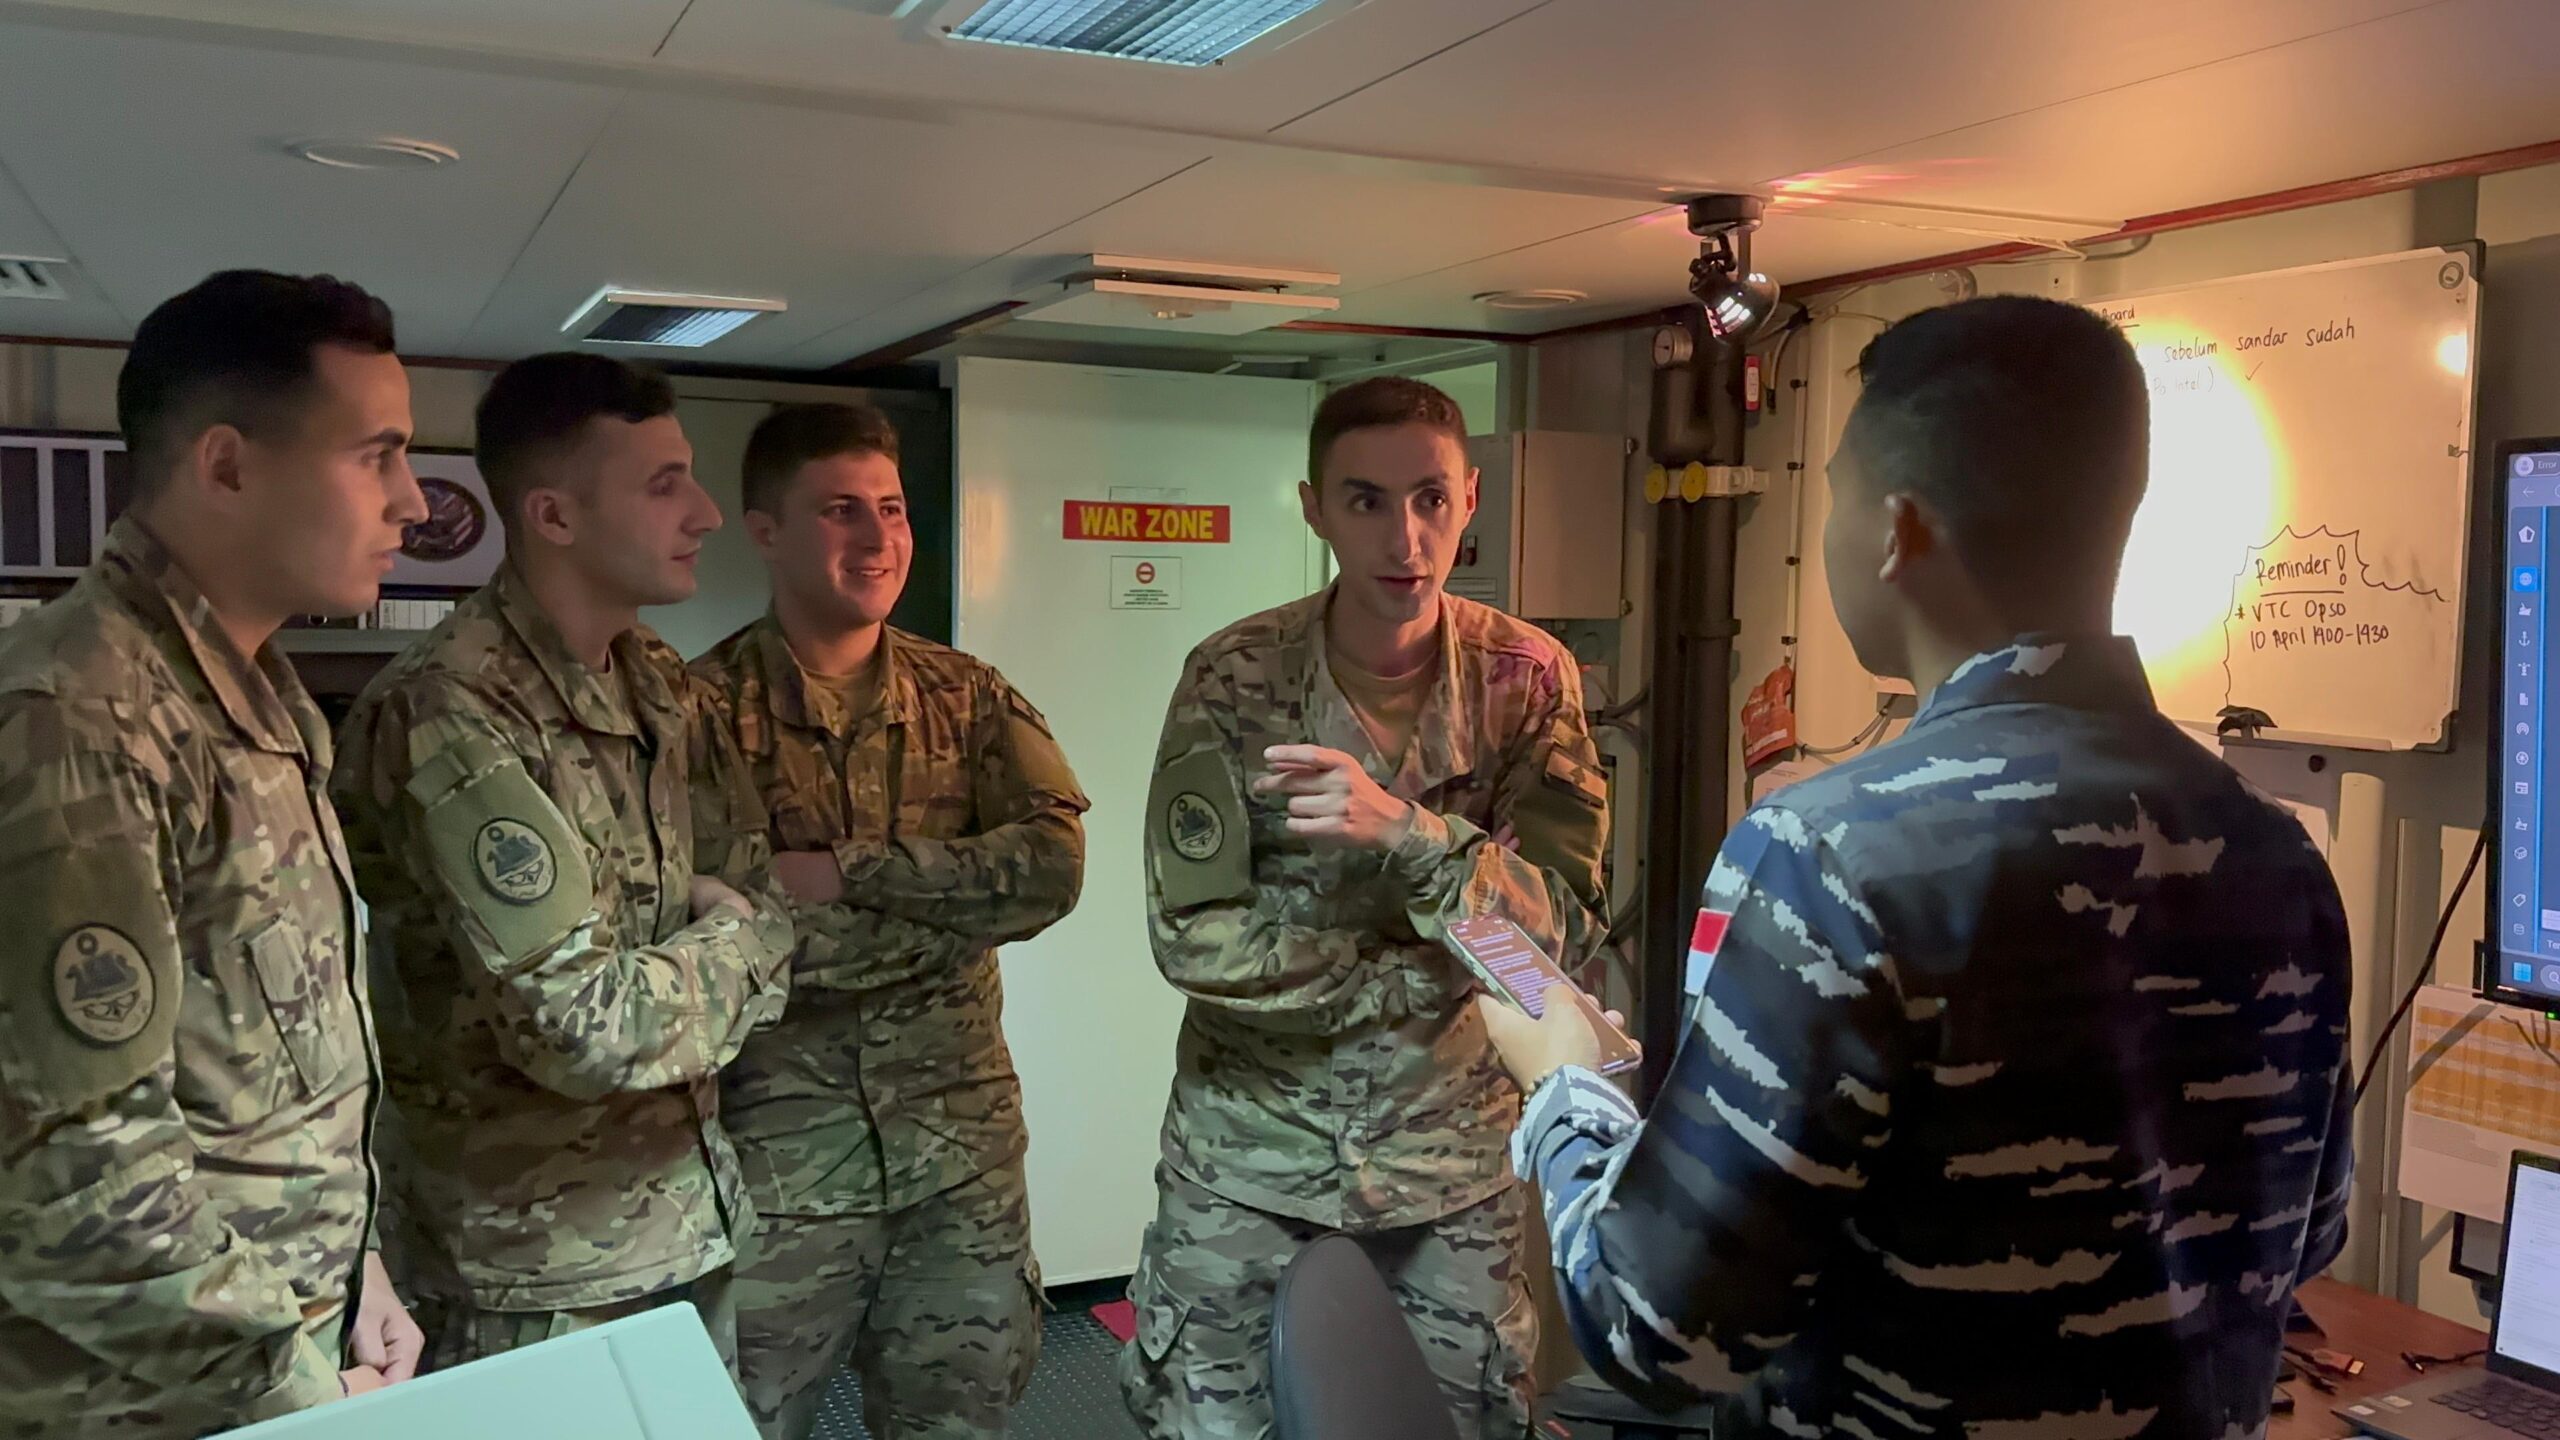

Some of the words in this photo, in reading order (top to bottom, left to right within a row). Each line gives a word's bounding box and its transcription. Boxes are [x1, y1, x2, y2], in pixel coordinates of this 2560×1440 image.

[2236, 327, 2288, 351] sandar
[1080, 506, 1139, 537] WAR
[1145, 508, 1214, 540] ZONE
[2252, 600, 2291, 622] VTC
[2250, 630, 2266, 652] 10
[2272, 626, 2306, 651] April
